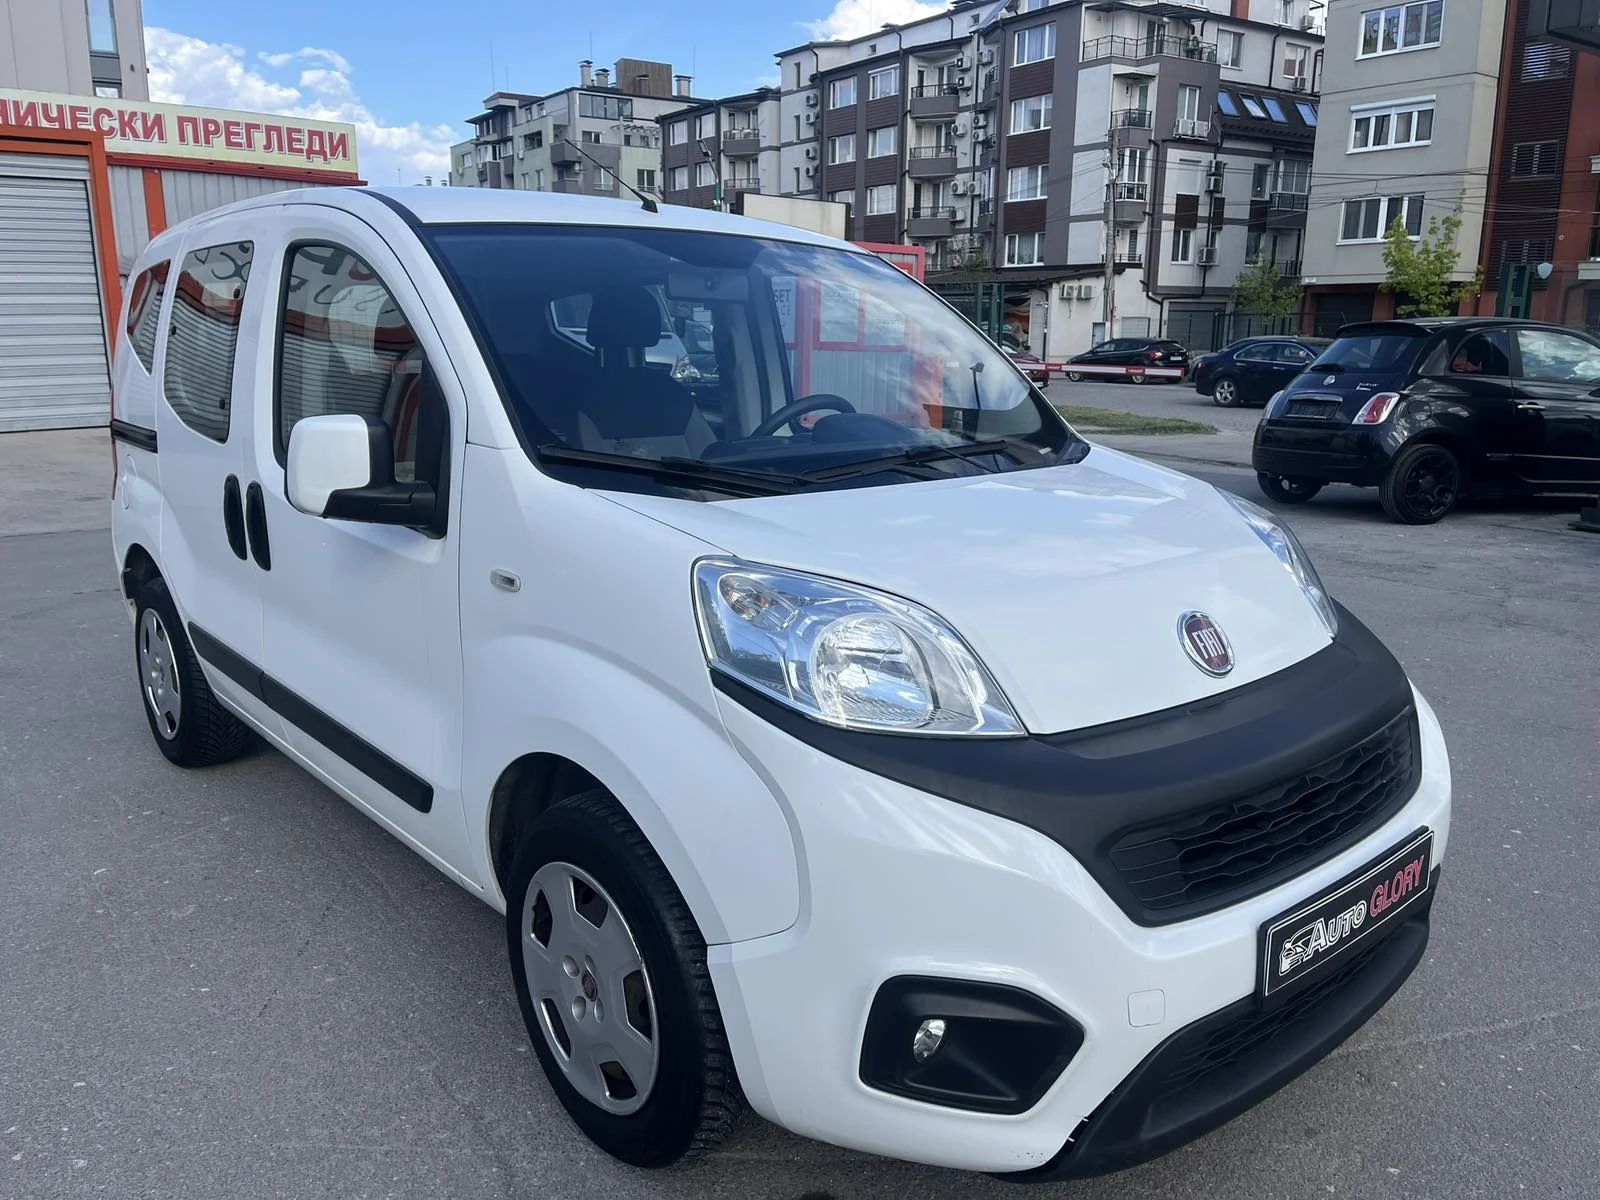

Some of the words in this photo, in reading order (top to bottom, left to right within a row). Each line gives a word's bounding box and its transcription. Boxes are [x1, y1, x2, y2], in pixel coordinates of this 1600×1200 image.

[176, 114, 350, 163] ПРЕГЛЕДИ
[1192, 627, 1225, 659] FIAT
[1369, 854, 1425, 917] GLORY
